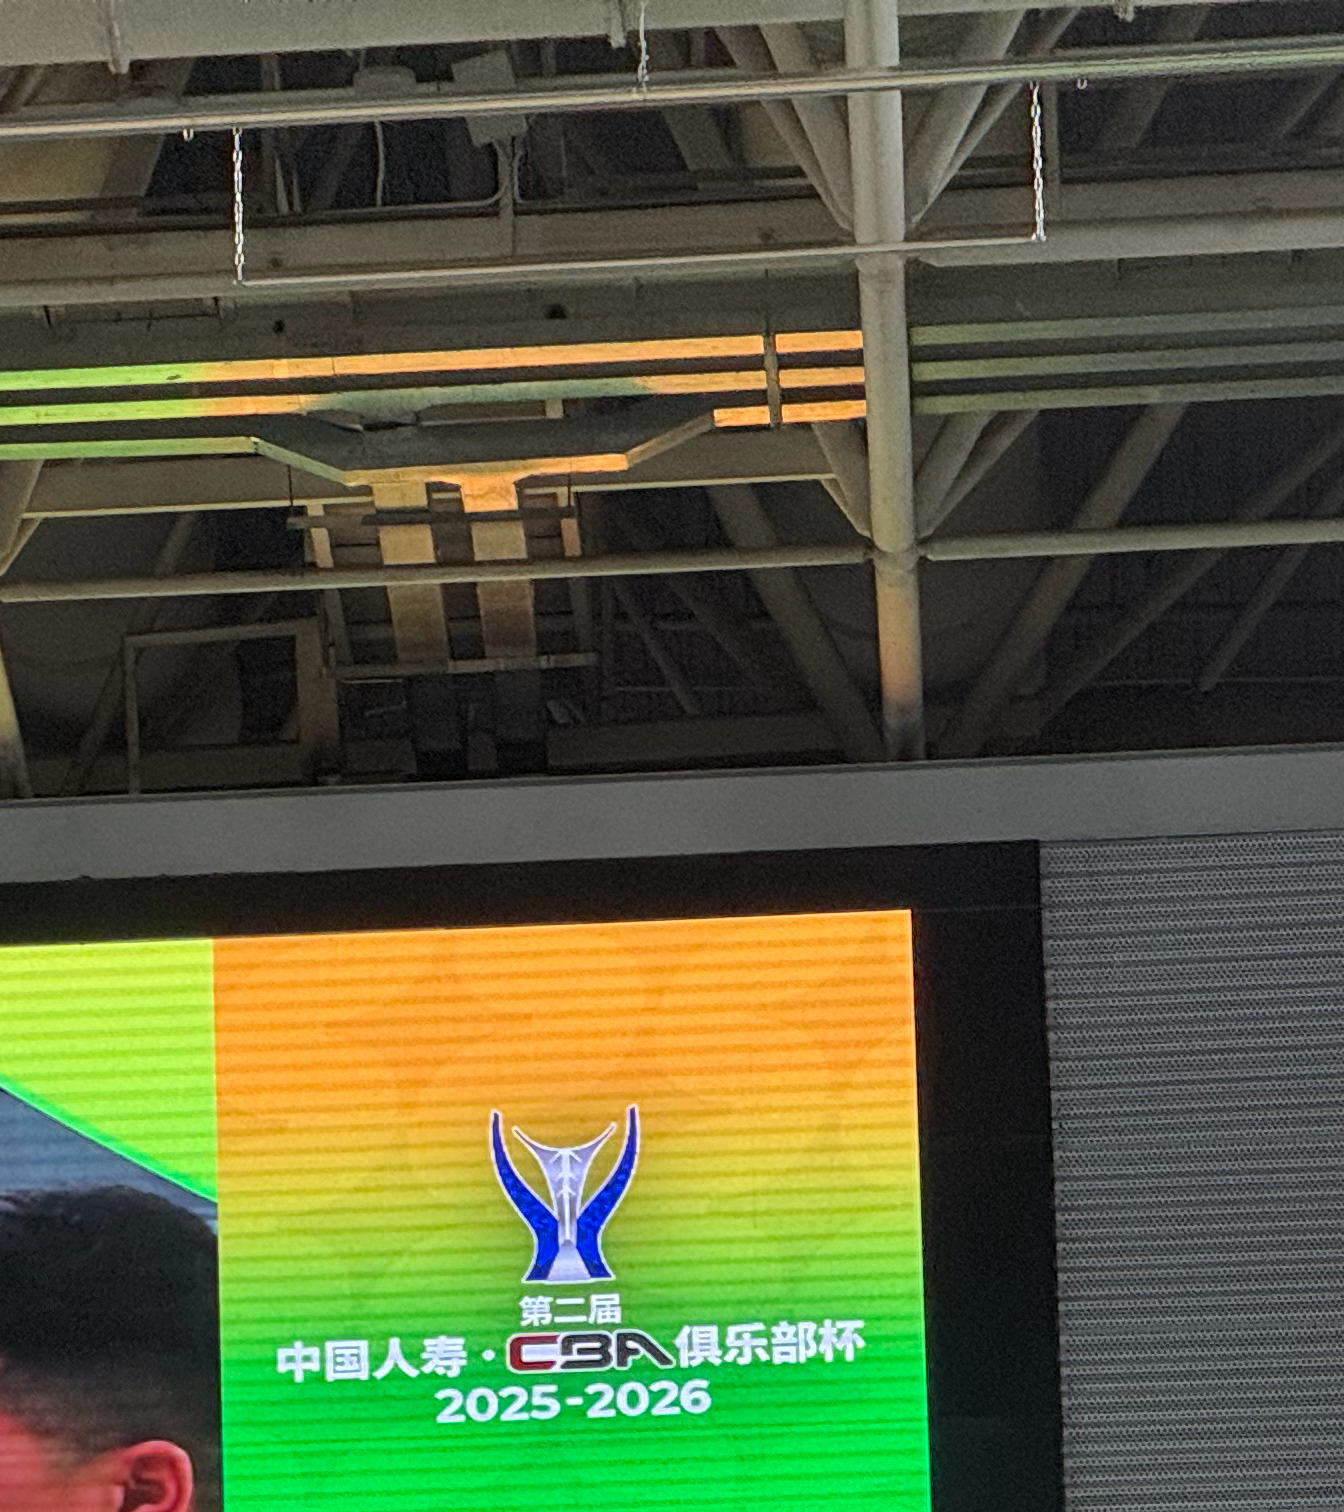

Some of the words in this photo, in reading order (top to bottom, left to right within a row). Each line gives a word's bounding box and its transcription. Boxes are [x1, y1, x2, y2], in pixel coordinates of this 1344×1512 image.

[518, 1293, 622, 1327] 第二届
[435, 1380, 711, 1425] 2025-2026
